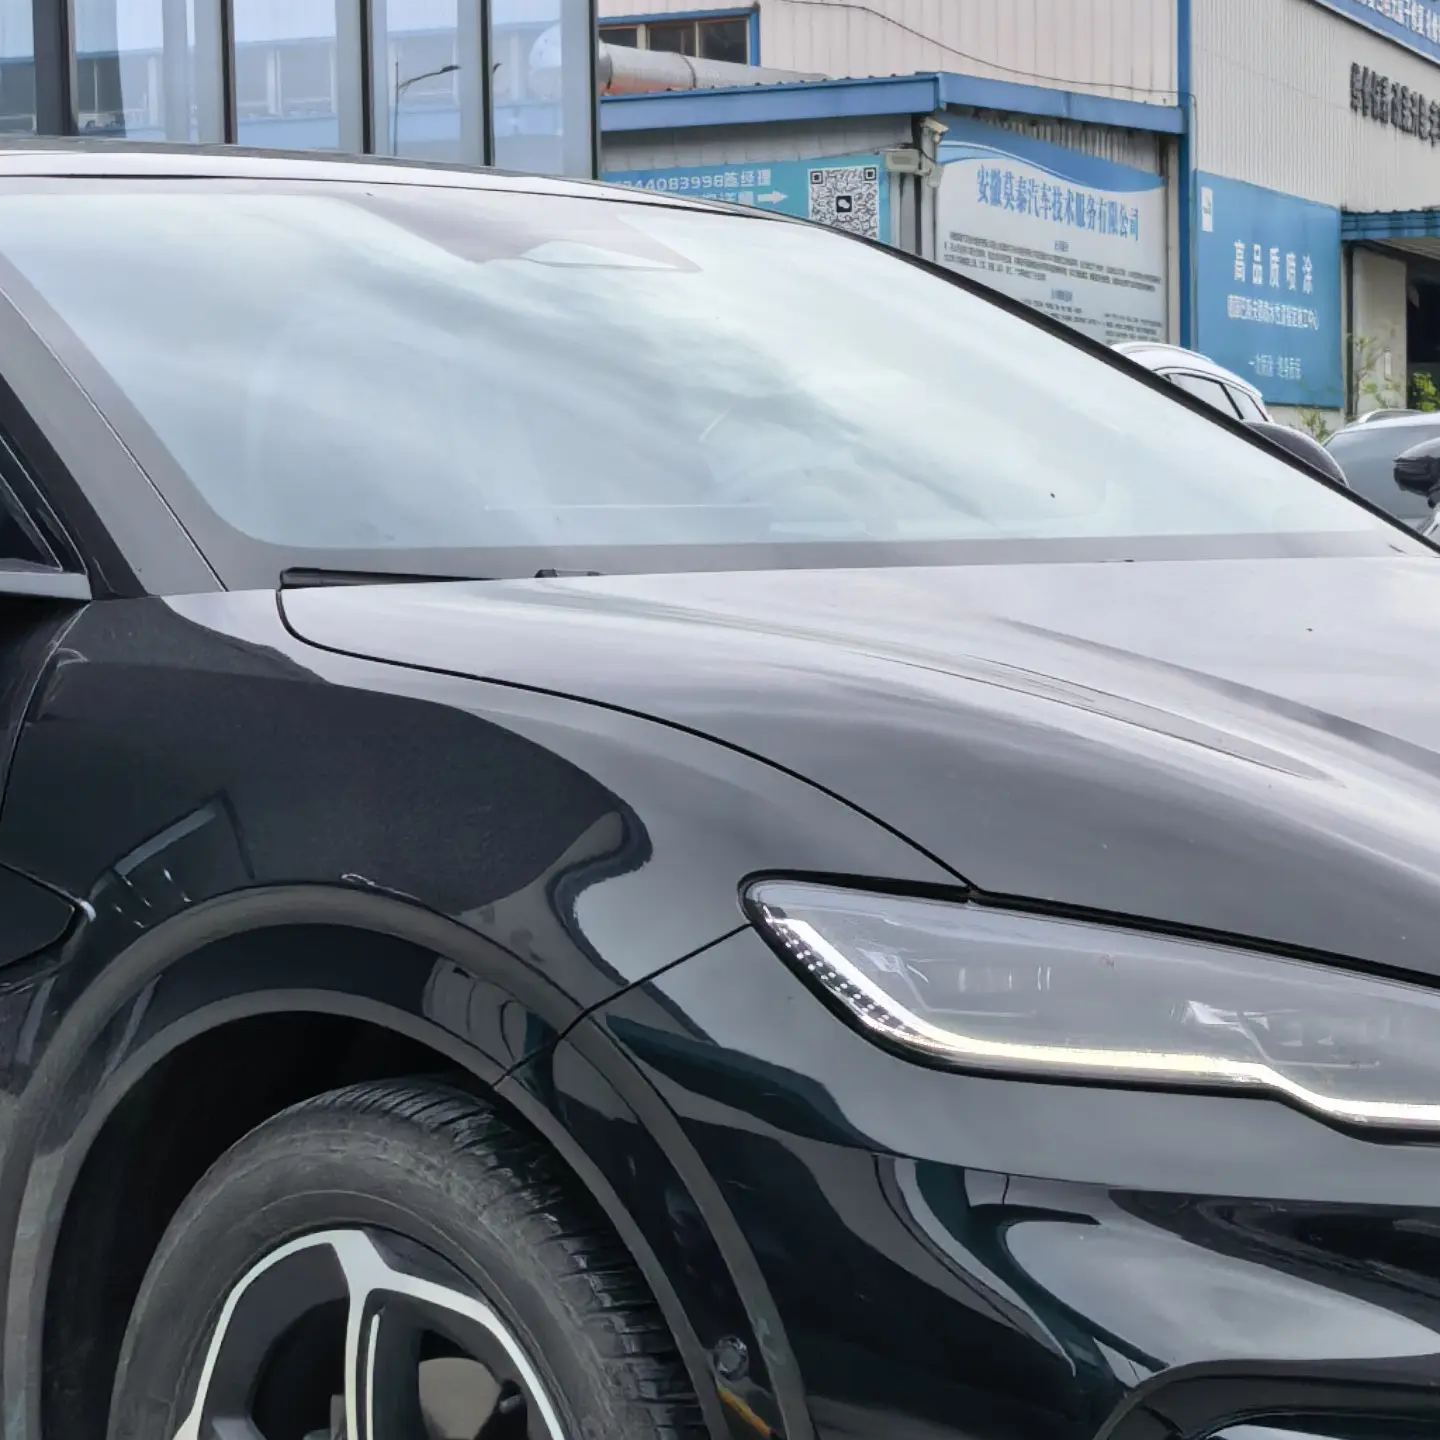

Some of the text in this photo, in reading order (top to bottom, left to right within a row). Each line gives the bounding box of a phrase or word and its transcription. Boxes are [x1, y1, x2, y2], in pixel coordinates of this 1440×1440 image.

[1233, 239, 1314, 294] 高品质喷涂
